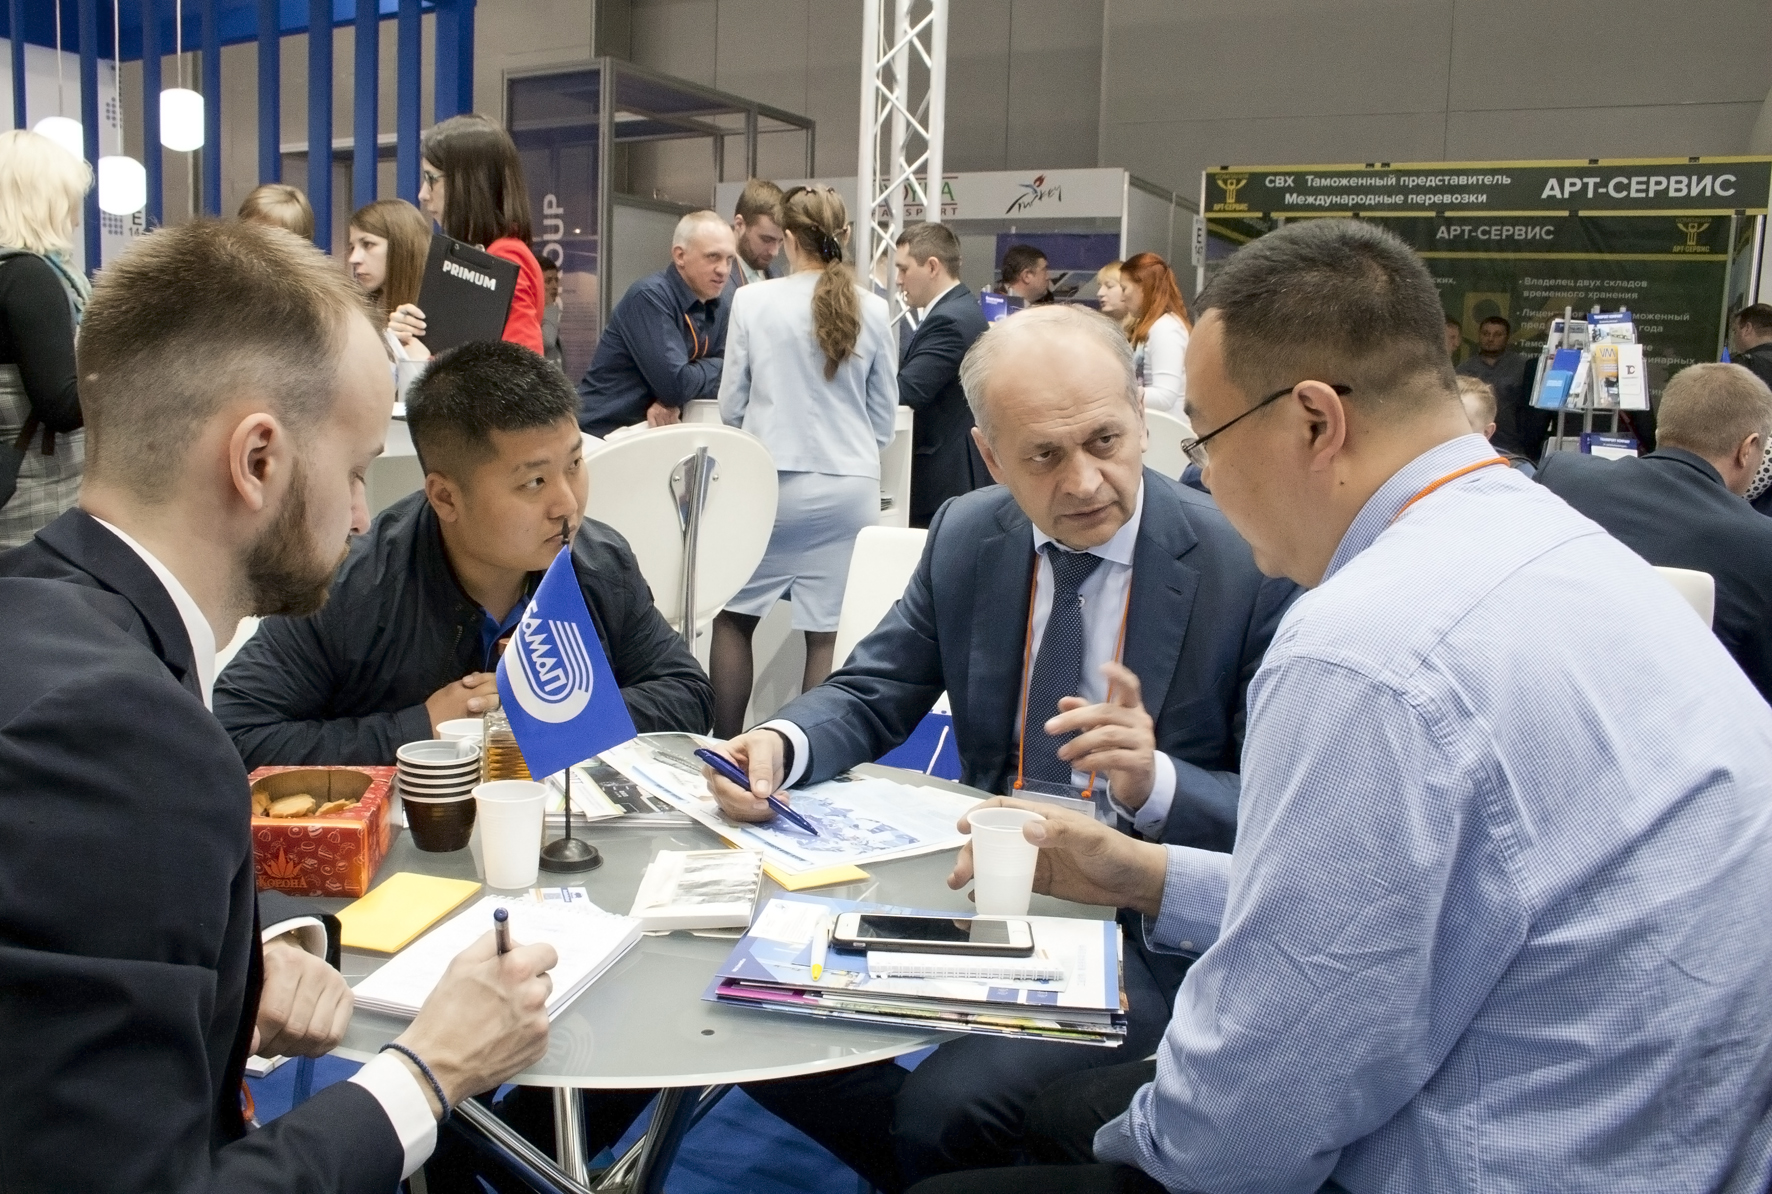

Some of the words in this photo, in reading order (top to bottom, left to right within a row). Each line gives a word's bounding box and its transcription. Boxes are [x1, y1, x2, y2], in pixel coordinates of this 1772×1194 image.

[1265, 176, 1295, 187] СВХ
[1305, 174, 1396, 187] Таможенный
[1400, 174, 1511, 187] представитель
[1541, 174, 1737, 198] АРТ-СЕРВИС
[1285, 193, 1404, 206] Международные
[1408, 193, 1487, 206] перевозки
[1436, 226, 1554, 239] АРТ-СЕРВИС
[442, 260, 497, 291] PRIMUM
[1524, 277, 1574, 288] Владелец
[1576, 278, 1600, 288] двух
[1604, 278, 1648, 288] складов
[1523, 289, 1585, 300] временного
[1588, 291, 1638, 300] хранения
[1639, 325, 1663, 334] года
